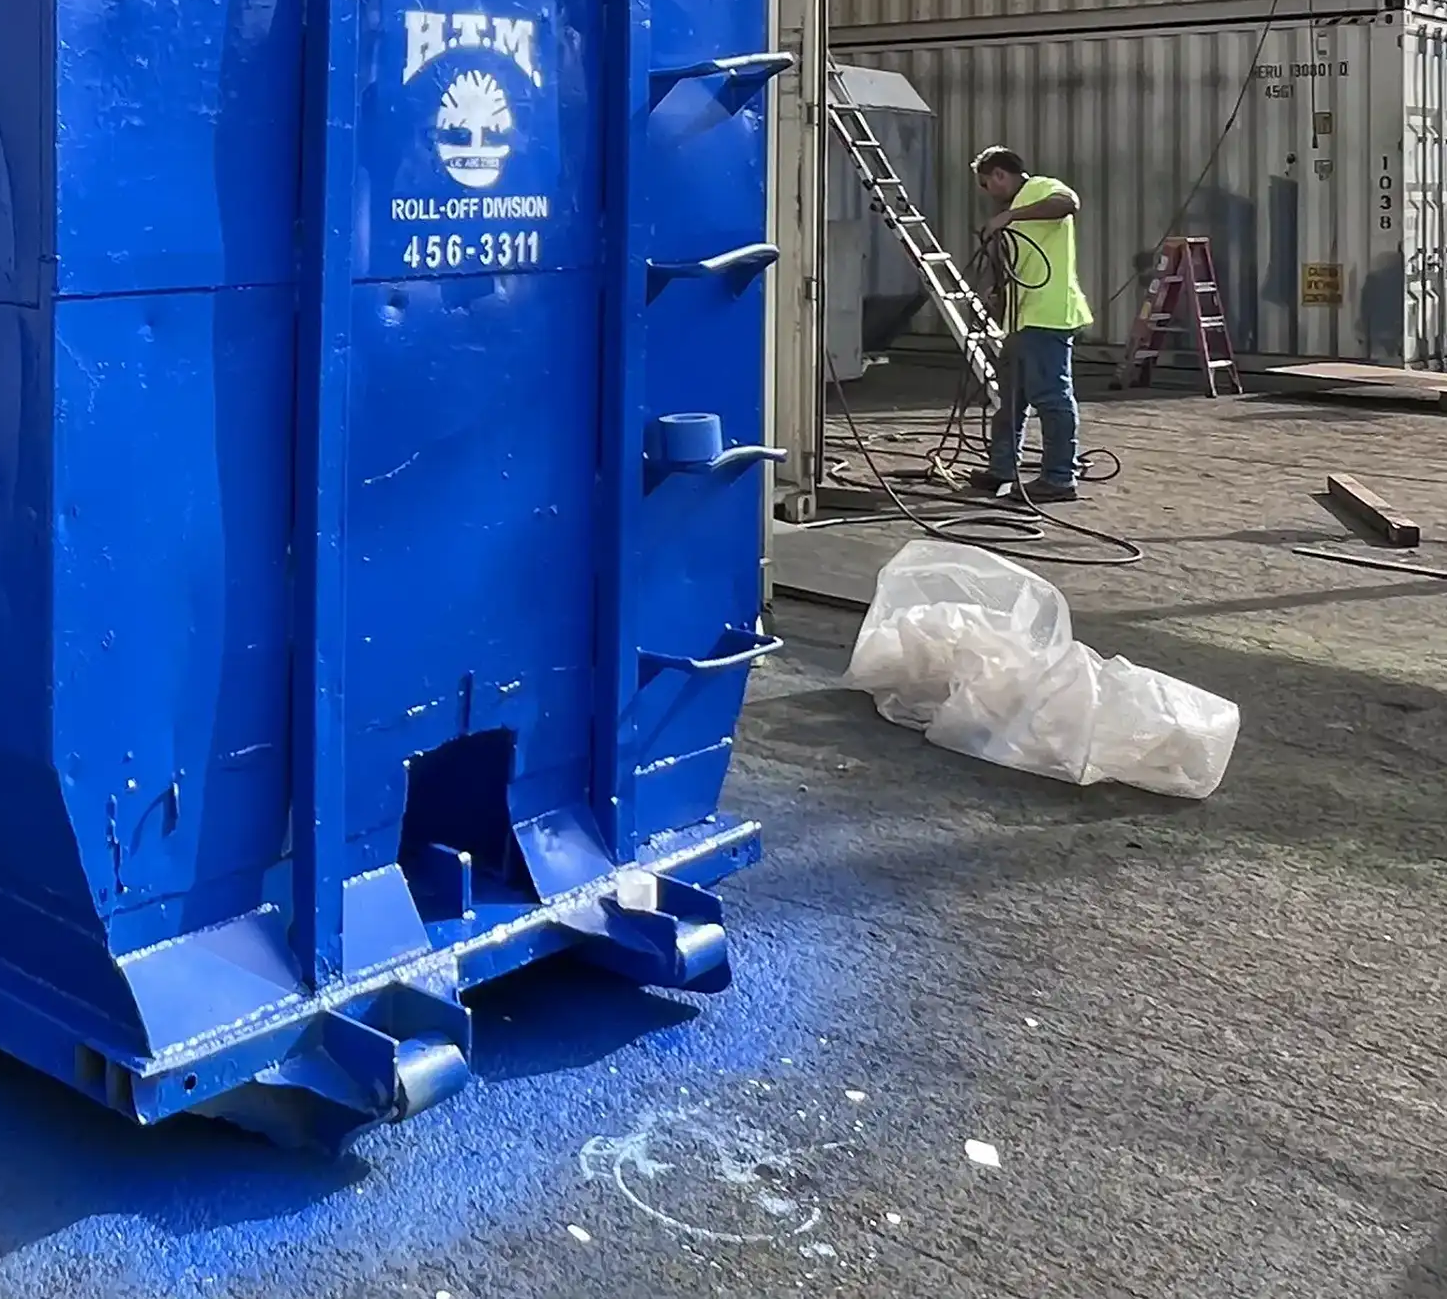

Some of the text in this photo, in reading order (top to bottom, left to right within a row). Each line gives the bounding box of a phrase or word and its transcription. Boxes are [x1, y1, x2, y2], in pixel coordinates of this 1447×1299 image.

[402, 10, 541, 88] H.T.M.
[392, 196, 548, 220] ROLL-OFF DIVISION
[1379, 155, 1393, 230] 1038
[403, 230, 539, 268] 456-3311
